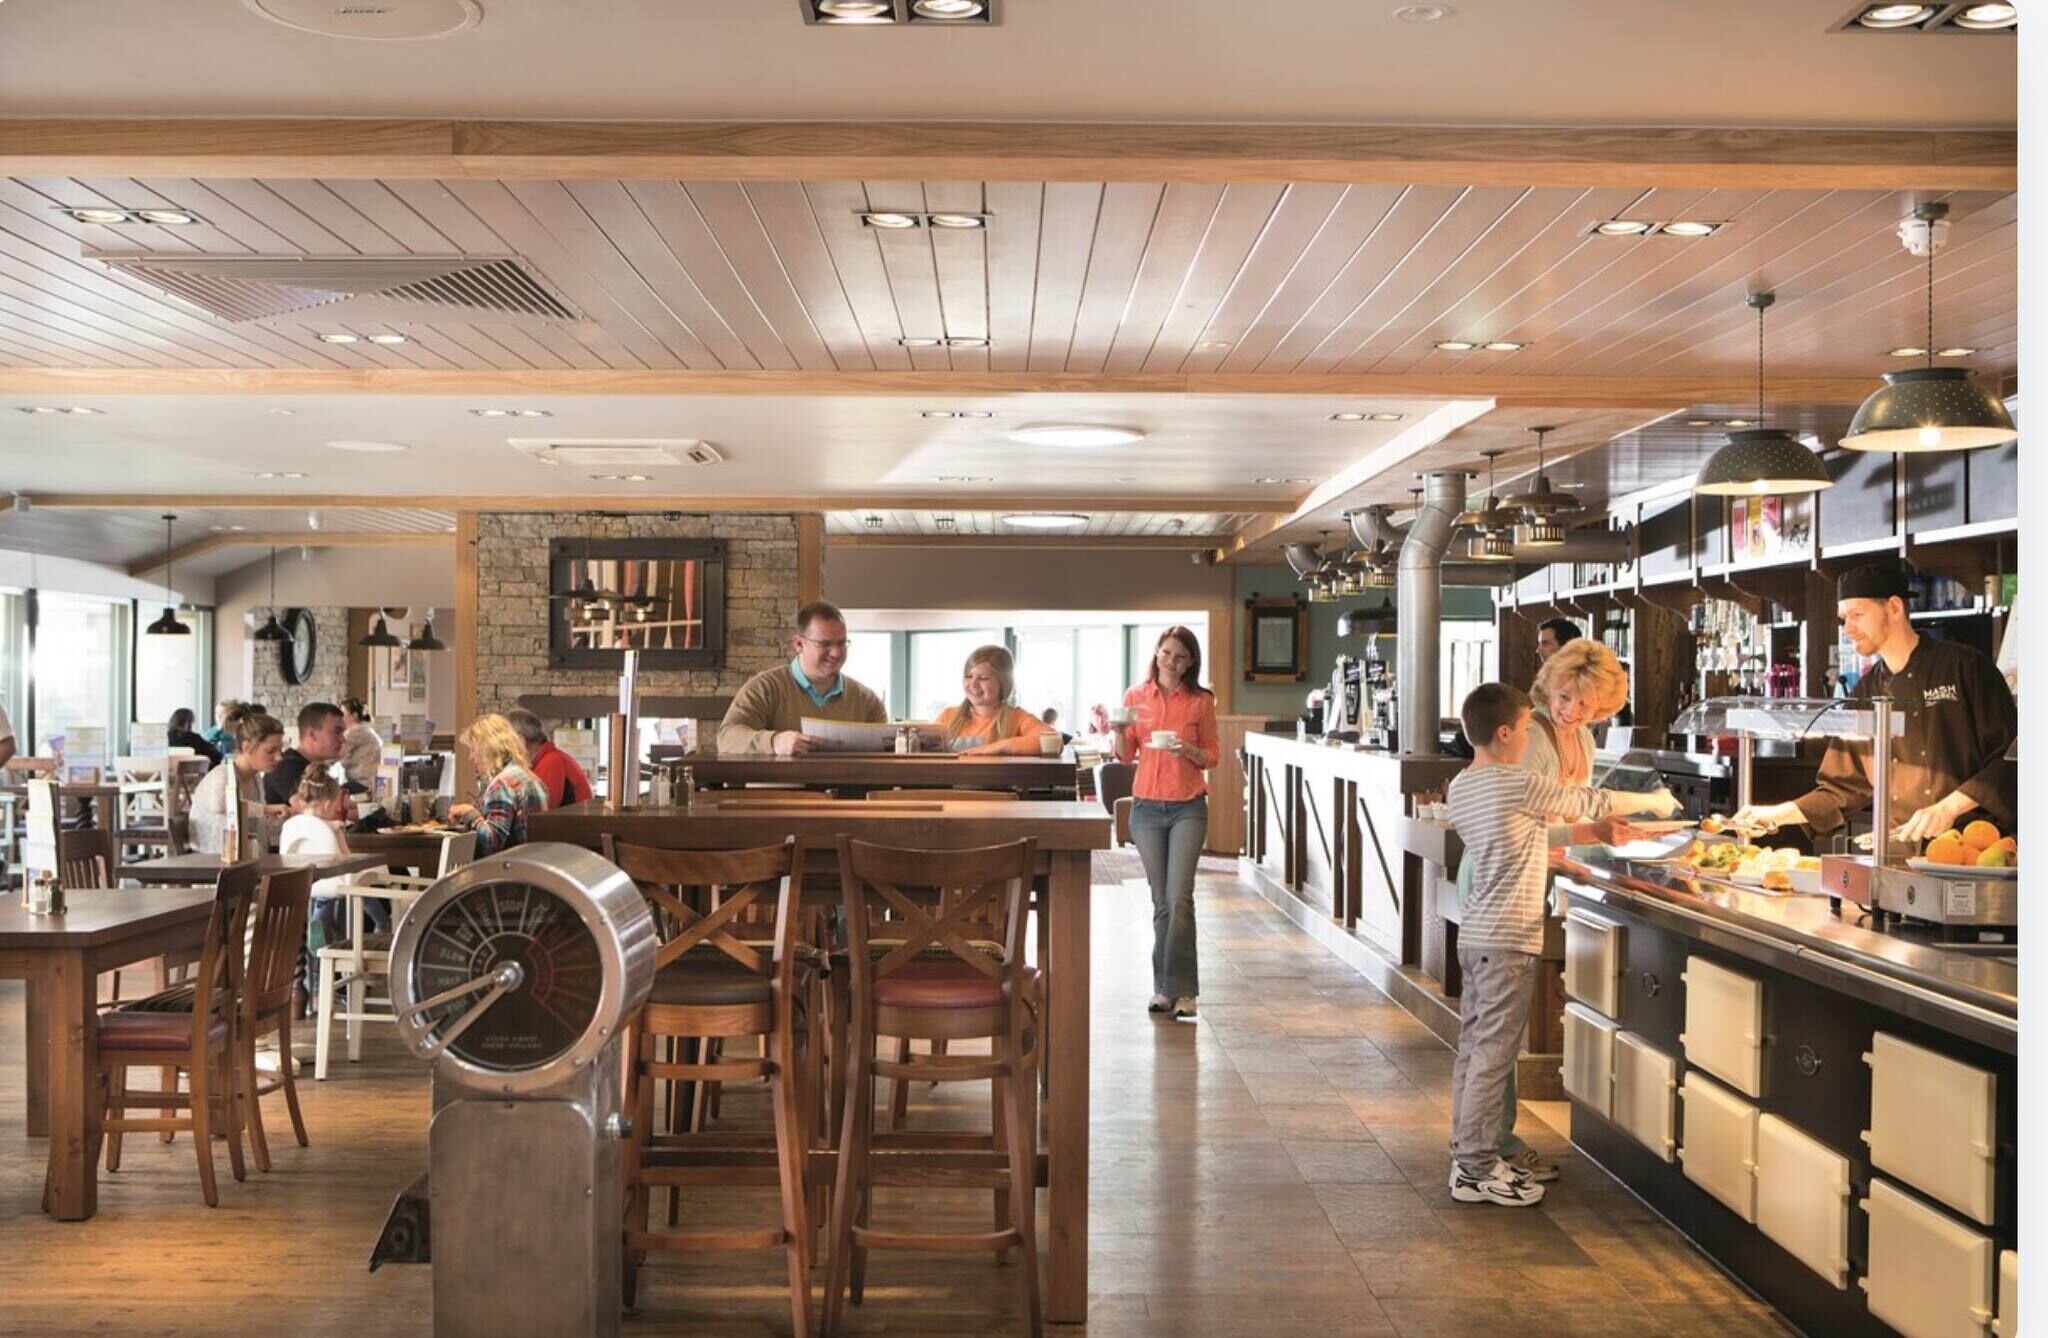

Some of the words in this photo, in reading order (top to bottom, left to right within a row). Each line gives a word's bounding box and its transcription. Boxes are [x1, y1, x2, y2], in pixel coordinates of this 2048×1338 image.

[1923, 684, 1957, 700] MASH
[499, 900, 523, 913] STOP
[439, 947, 466, 962] SLOW
